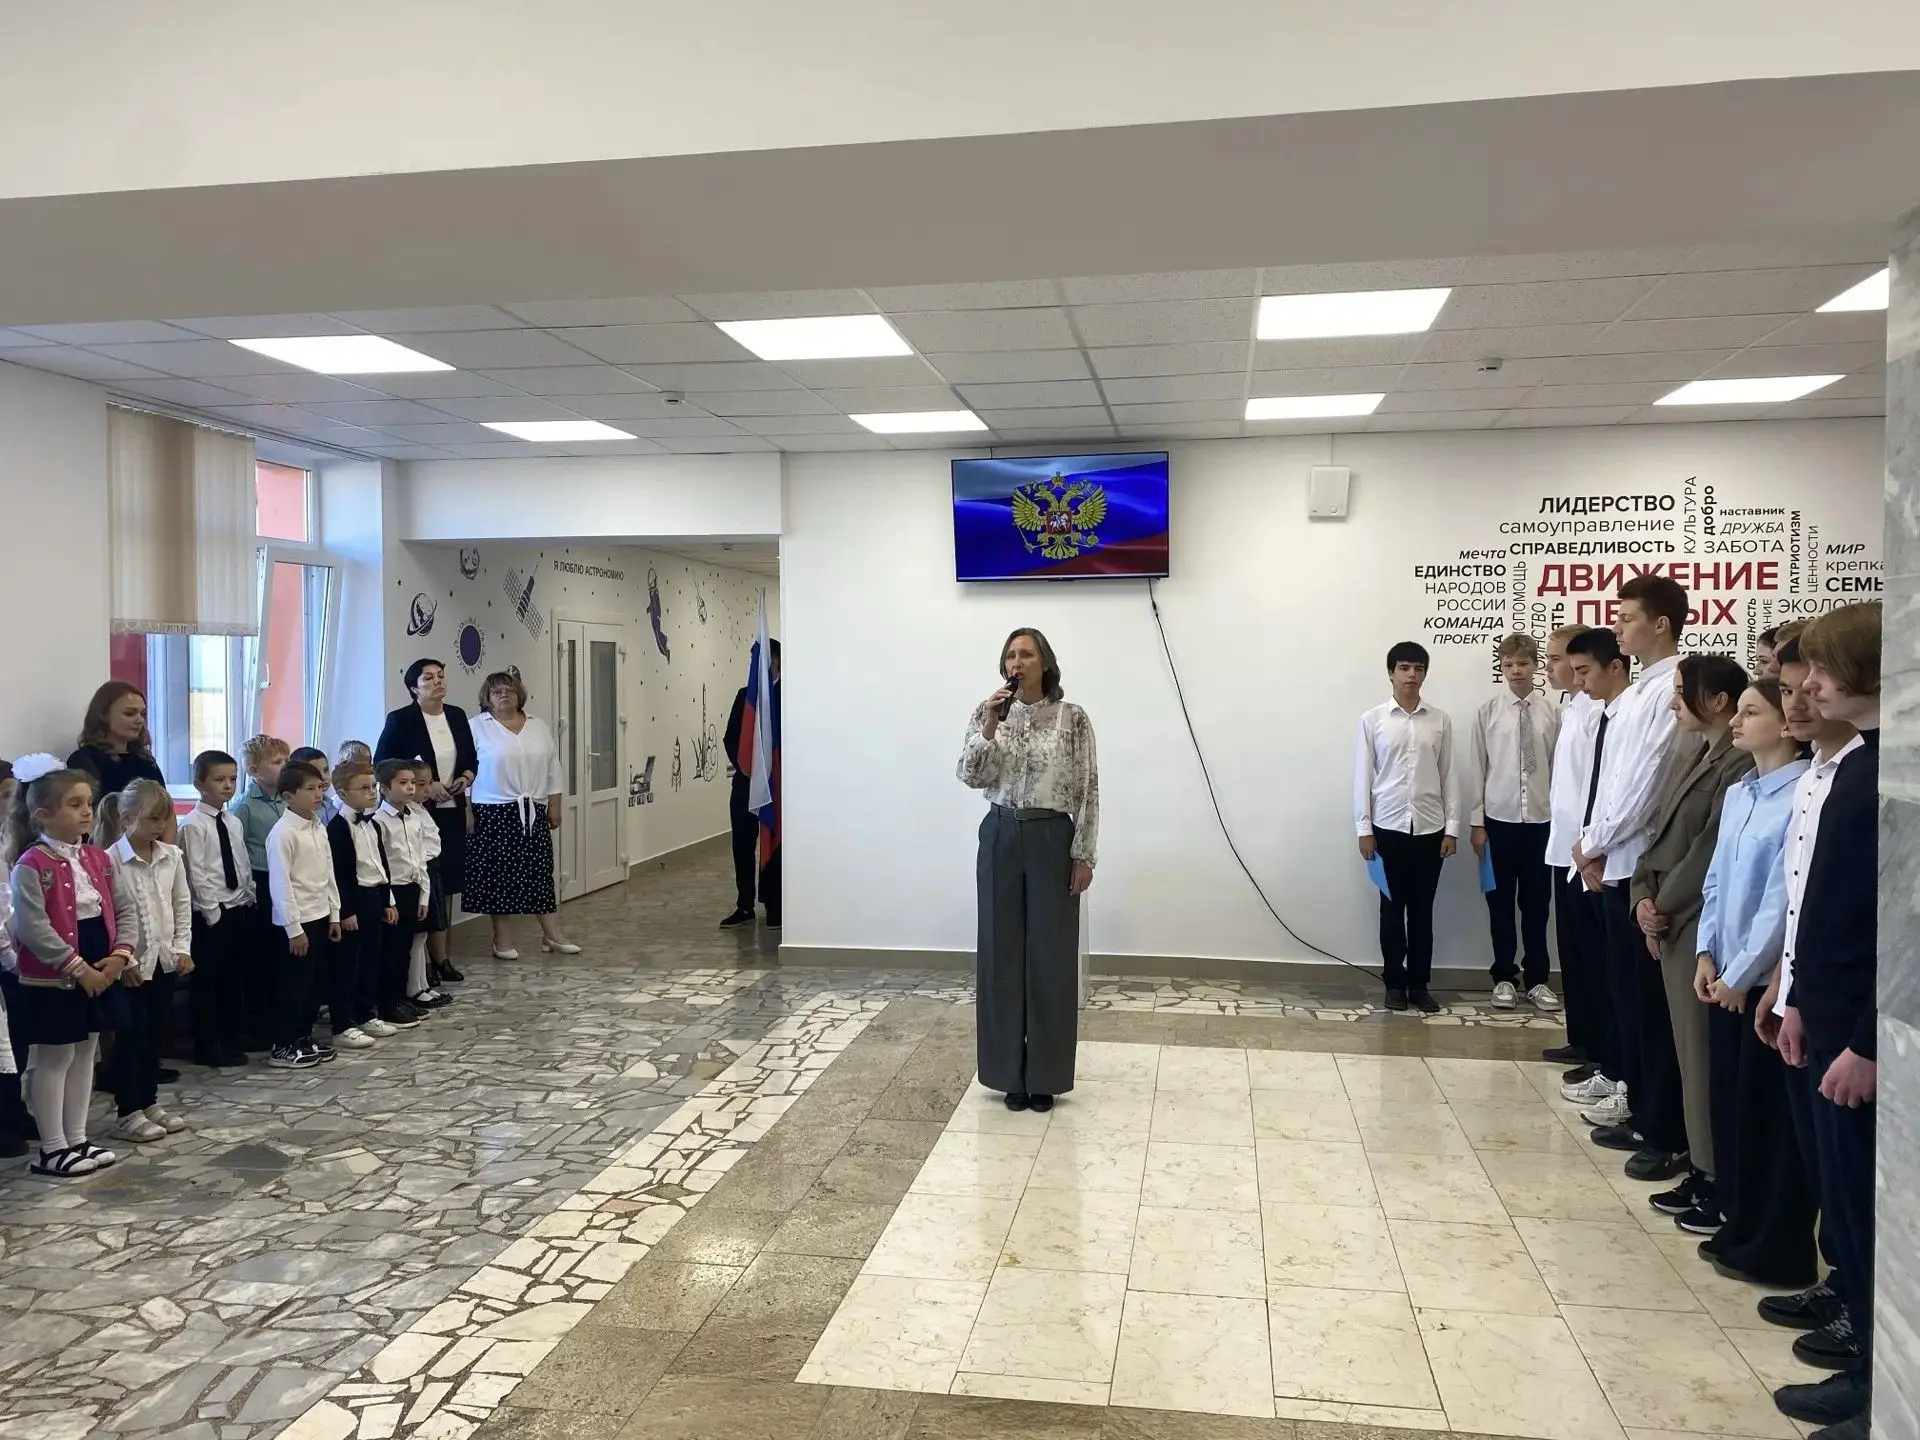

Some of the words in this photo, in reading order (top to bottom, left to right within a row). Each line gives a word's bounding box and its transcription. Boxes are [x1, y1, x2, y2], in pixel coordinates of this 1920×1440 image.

[1539, 494, 1675, 515] ЛИДЕРСТВО
[1701, 485, 1717, 536] добро
[1719, 507, 1785, 516] наставник
[1684, 476, 1697, 554] КУЛЬТУРА
[1500, 519, 1675, 536] самоуправление
[1719, 522, 1785, 536] ДРУЖБА
[1509, 540, 1675, 556] СПРАВЕДЛИВОСТЬ
[1704, 539, 1785, 554] ЗАБОТА
[1790, 510, 1801, 594] ПАТРИОТИЗМ
[1825, 544, 1866, 555] МИР
[1459, 549, 1507, 560] мечта
[1807, 525, 1819, 593] ЦЕННОСТИ
[554, 561, 559, 571] Я
[1414, 564, 1506, 579] ЕДИНСТВО
[1825, 560, 1884, 574] крепк
[1425, 582, 1506, 595] НАРОДОВ
[1825, 577, 1884, 592] СЕМЬ
[1437, 599, 1506, 611] РОССИИ
[1577, 599, 1738, 625] ПЕЫХ
[1423, 617, 1505, 630] КОМАНДА
[1432, 634, 1489, 645] ПРОЕКТ
[1746, 598, 1757, 670] активность
